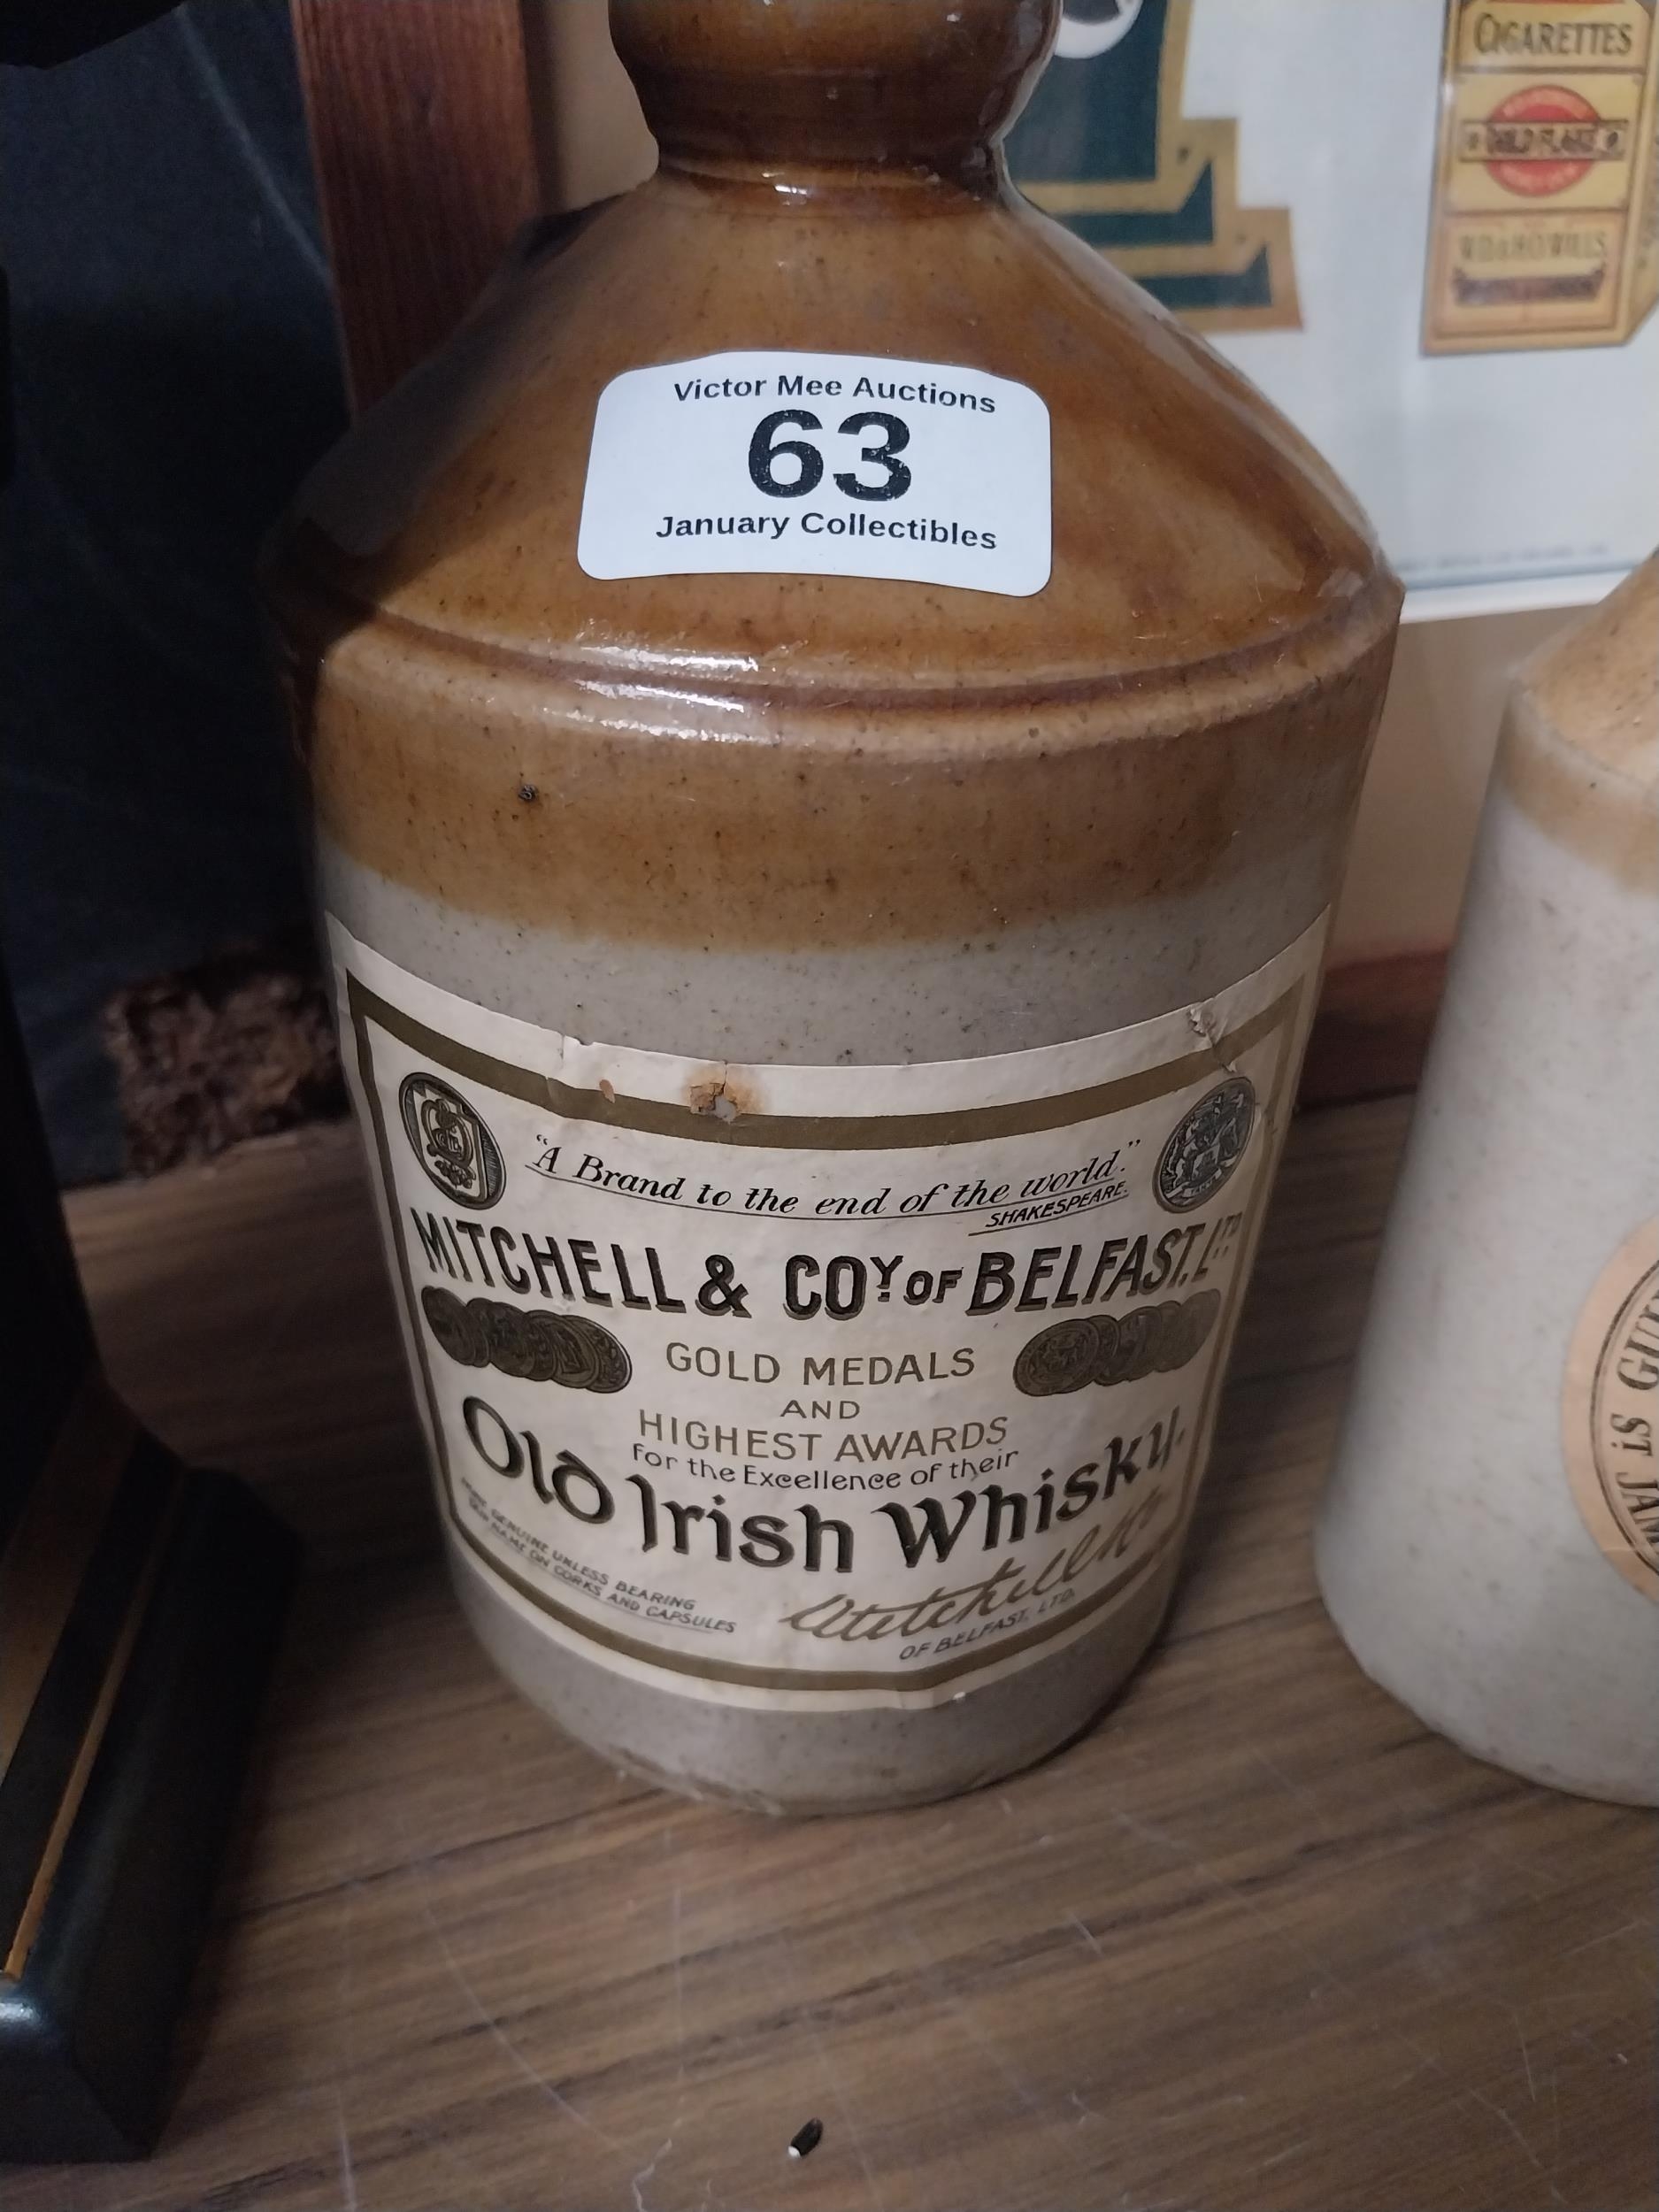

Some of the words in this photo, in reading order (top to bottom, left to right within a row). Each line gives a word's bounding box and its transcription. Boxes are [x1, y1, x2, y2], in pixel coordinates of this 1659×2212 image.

[1473, 12, 1633, 56] CIGARETTES
[672, 375, 767, 403] Victor
[777, 374, 843, 398] Mee
[851, 375, 997, 414] Auctions
[747, 408, 913, 503] 63
[655, 513, 790, 541] January
[800, 511, 998, 550] Collectibles
[572, 1153, 683, 1201] Brand
[697, 1184, 732, 1207] to
[743, 1187, 799, 1215] the
[815, 1187, 892, 1216] end
[899, 1183, 948, 1213] of
[950, 1179, 1010, 1210] the
[410, 1206, 687, 1314] MITCHELL
[695, 1253, 752, 1319] &
[902, 1266, 964, 1306] OF
[665, 1341, 780, 1384] GOLD
[802, 1347, 975, 1386] MEDALS
[779, 1399, 861, 1420] AND
[638, 1409, 823, 1462] HIGHEST
[833, 1416, 1009, 1463] AWARDS
[462, 1395, 616, 1525] Old
[624, 1472, 855, 1574] Irish
[687, 1457, 736, 1484] the
[743, 1463, 902, 1491] Excellence
[910, 1463, 943, 1486] of
[949, 1448, 1019, 1482] their
[552, 1549, 611, 1586] UNLESS
[615, 1579, 697, 1611] BEARING
[553, 1564, 603, 1597] CORKS
[606, 1593, 641, 1612] AND
[645, 1605, 738, 1633] CAPSULES
[898, 1641, 932, 1662] OF
